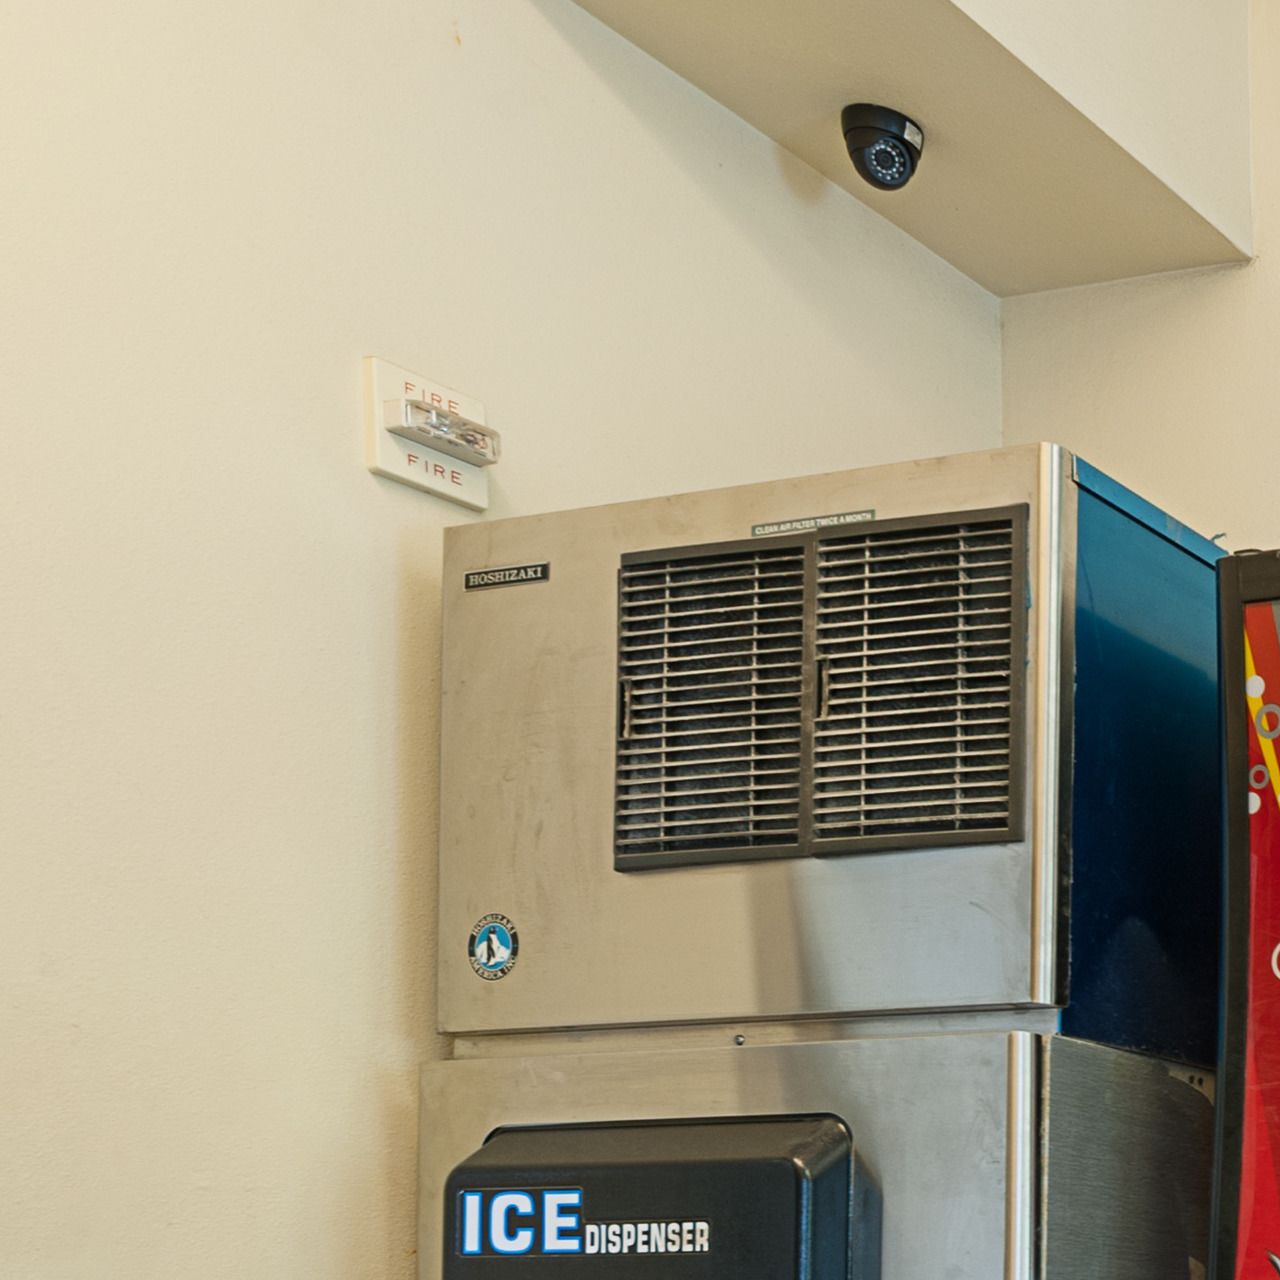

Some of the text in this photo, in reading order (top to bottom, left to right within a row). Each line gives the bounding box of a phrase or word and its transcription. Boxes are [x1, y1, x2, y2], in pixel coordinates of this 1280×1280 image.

[404, 382, 460, 416] FIRE
[407, 453, 463, 486] FIRE
[468, 566, 543, 586] HOSHIZAKI
[461, 1188, 711, 1255] ICE DISPENSER
